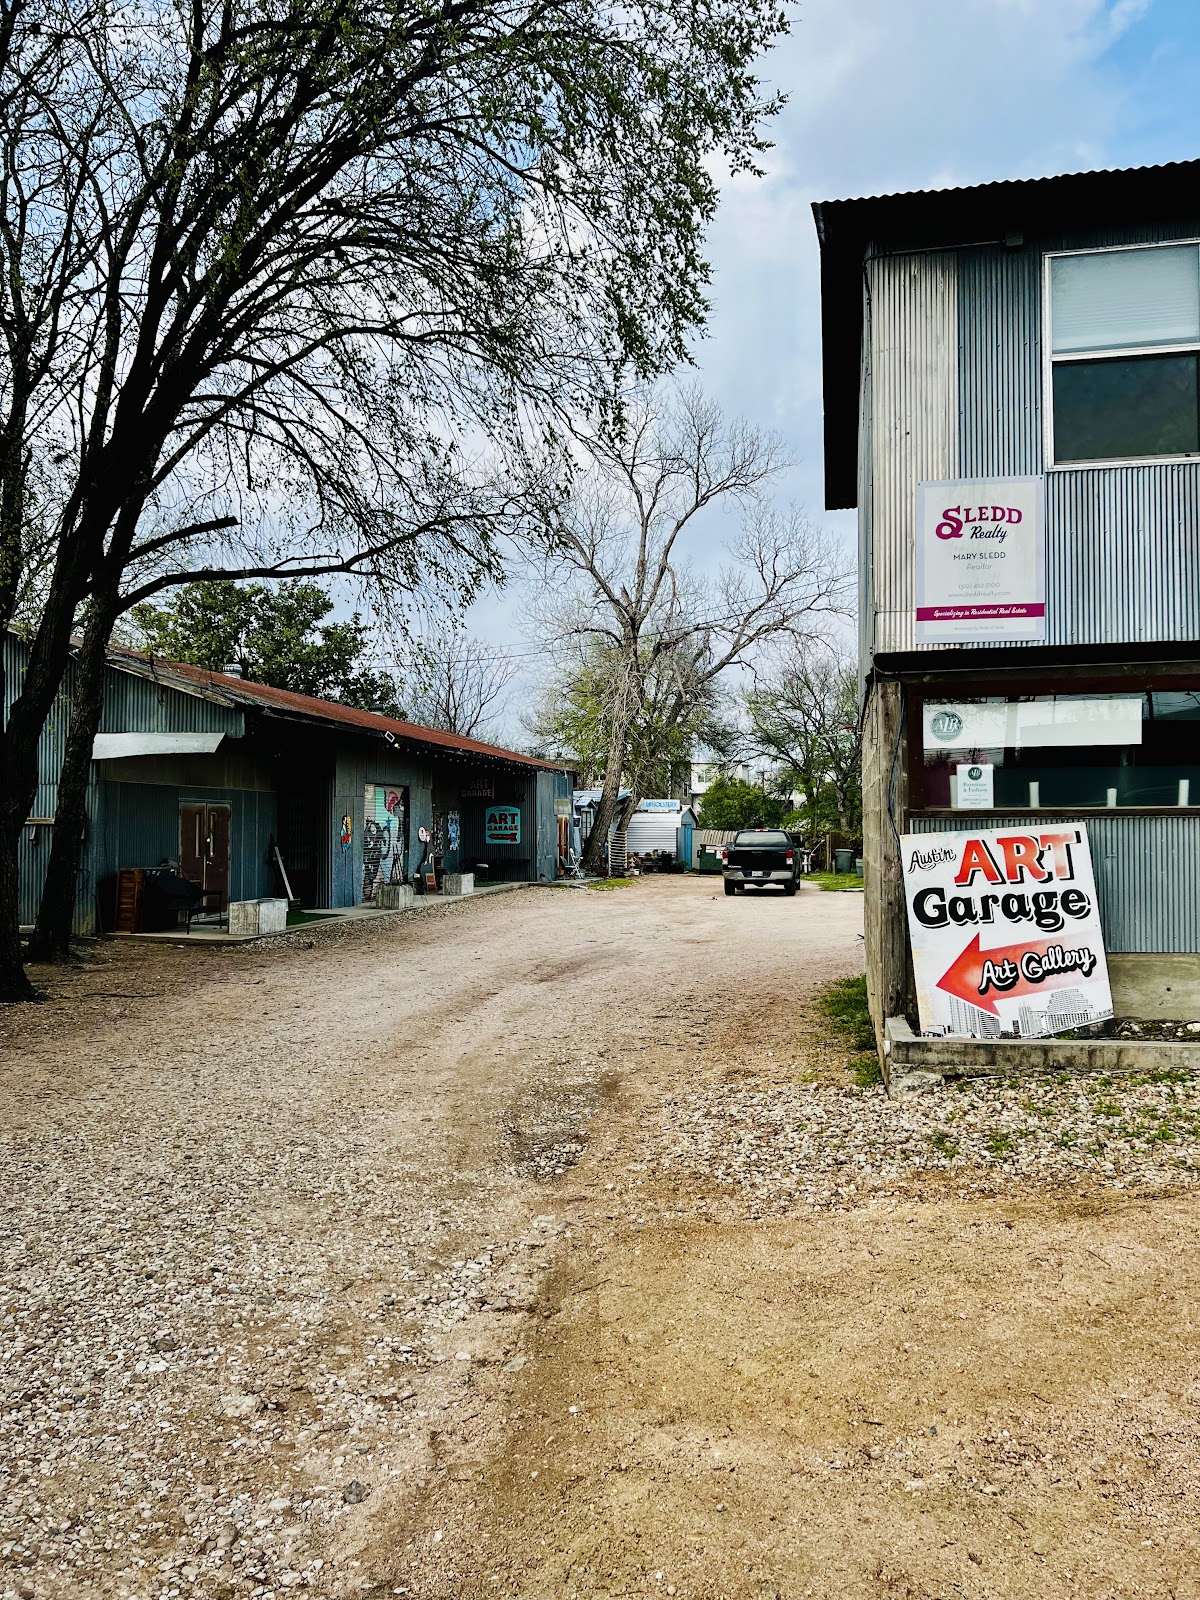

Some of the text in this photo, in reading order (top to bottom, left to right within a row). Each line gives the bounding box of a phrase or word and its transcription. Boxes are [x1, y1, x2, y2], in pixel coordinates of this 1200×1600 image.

[936, 505, 1023, 540] SLEDD
[970, 524, 1008, 543] Realty
[979, 551, 1006, 560] SLEDD
[933, 609, 964, 618] Specializing
[970, 607, 999, 615] Residential
[999, 607, 1011, 615] Real
[1011, 606, 1028, 614] Estate
[471, 779, 489, 790] ART
[461, 789, 492, 798] GARAGE
[487, 813, 519, 825] ART
[908, 830, 1081, 887] Austin ART
[912, 887, 1091, 933] Garage
[978, 945, 1097, 995] Art Gallery
